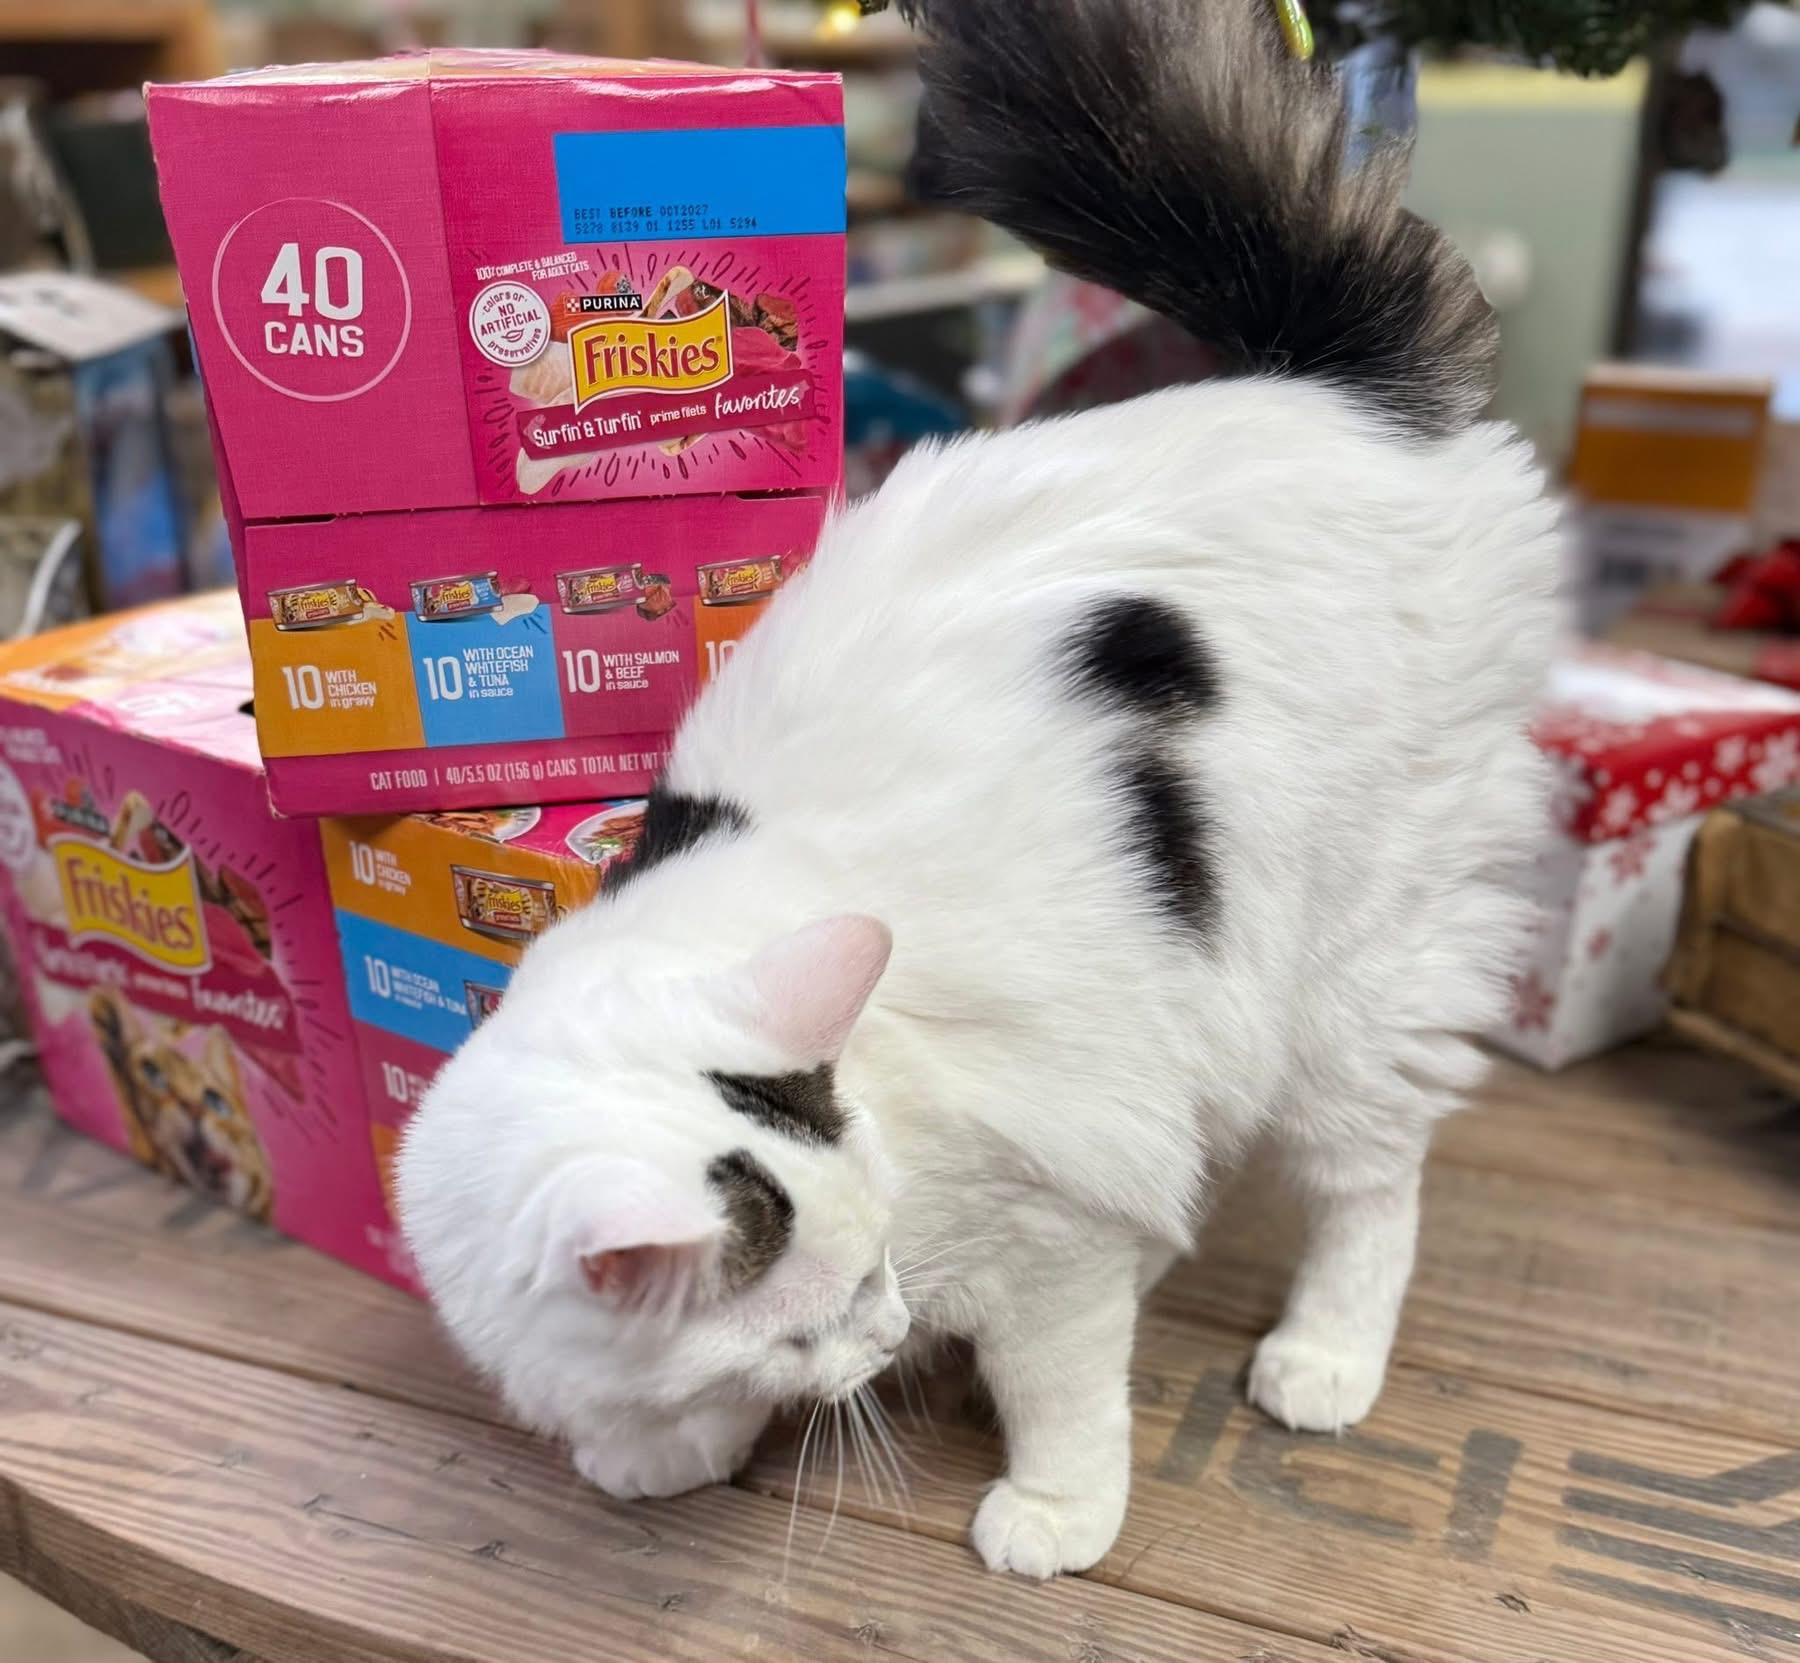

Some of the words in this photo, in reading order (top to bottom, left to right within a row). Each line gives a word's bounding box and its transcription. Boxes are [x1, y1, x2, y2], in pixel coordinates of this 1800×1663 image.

[574, 207, 600, 220] BEST
[609, 206, 652, 219] BEFORE
[659, 204, 709, 218] OCT2027
[646, 220, 659, 233] 01
[667, 219, 696, 231] 1255
[475, 266, 495, 281] 100%
[495, 260, 534, 277] COMPLETE
[534, 258, 541, 269] &
[541, 251, 577, 268] BALANCED
[531, 270, 547, 281] FOR
[547, 263, 570, 279] ADULT
[570, 260, 590, 273] CATS
[260, 242, 363, 320] 40
[482, 291, 511, 313] colors
[512, 292, 526, 303] or
[498, 303, 516, 317] NO
[582, 297, 640, 311] PURINA
[480, 309, 542, 337] ARTIFICIAL
[264, 321, 364, 358] CANS
[487, 327, 542, 359] preservatives
[584, 331, 721, 388] Friskies
[533, 420, 582, 448] Surfin'
[584, 419, 594, 438] &
[594, 410, 642, 436] Turfin'
[650, 408, 681, 427] prime
[680, 403, 707, 421] filets
[714, 384, 801, 419] favorites
[463, 647, 494, 662] WITH
[496, 645, 534, 659] OCEAN
[603, 653, 633, 667] WITH
[635, 650, 680, 665] SALMON
[325, 669, 357, 683] WITH
[423, 656, 464, 700] 10
[465, 659, 529, 676] WHITEFISH
[562, 649, 600, 694] 10
[605, 669, 613, 679] &
[616, 666, 645, 679] BEEF
[282, 664, 325, 710] 10
[328, 681, 377, 697] CHICKEN
[468, 676, 477, 687] &
[478, 674, 510, 687] TUNA
[606, 682, 615, 691] in
[616, 680, 649, 690] sauce
[330, 698, 340, 708] in
[340, 696, 375, 710] gravy
[469, 689, 479, 699] in
[481, 687, 514, 698] sauce
[370, 772, 392, 791] CAT
[394, 769, 428, 789] FOOD
[446, 765, 485, 784] 40/5.5
[486, 763, 503, 782] OZ
[504, 760, 531, 782] (156
[532, 760, 544, 781] g)
[546, 758, 577, 777] CANS
[581, 755, 616, 775] TOTAL
[618, 753, 639, 772] NET
[641, 751, 658, 770] WT
[350, 841, 376, 886] 10
[65, 858, 196, 951] Friskies
[364, 955, 391, 998] 10
[381, 1061, 408, 1102] 10
